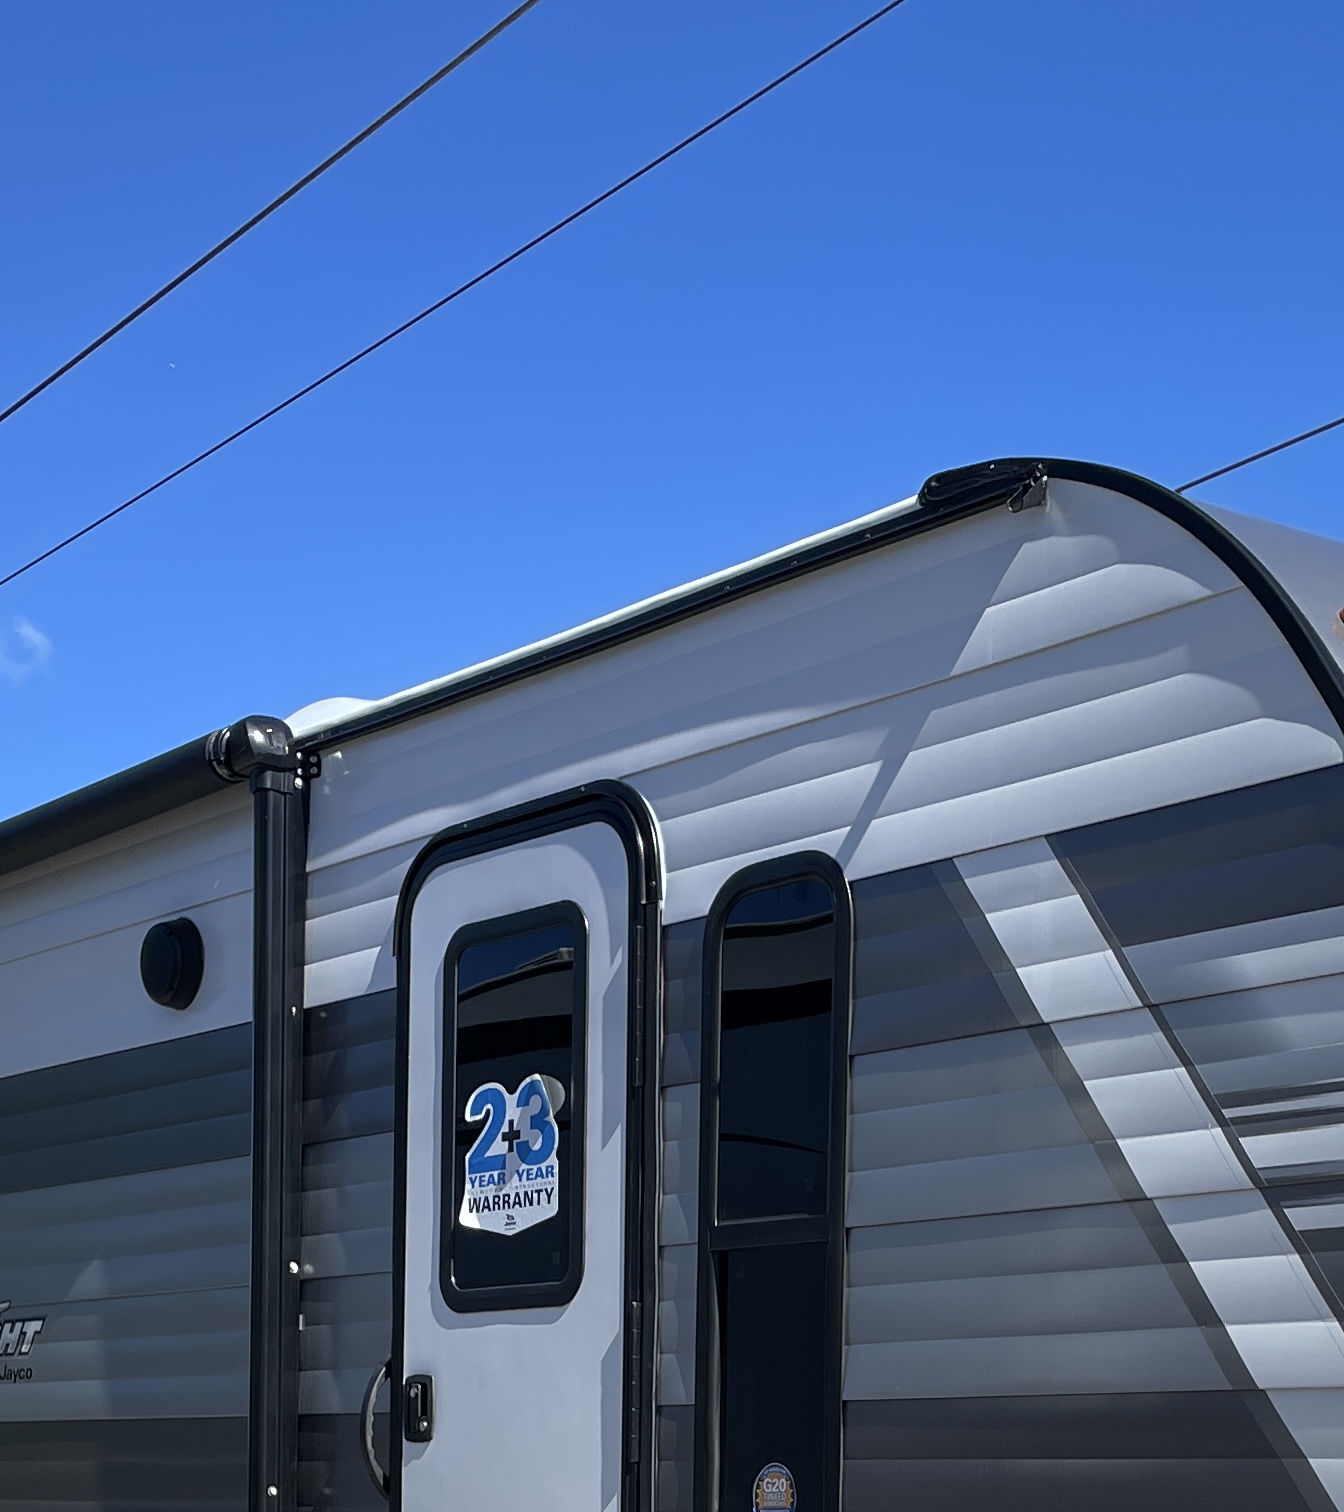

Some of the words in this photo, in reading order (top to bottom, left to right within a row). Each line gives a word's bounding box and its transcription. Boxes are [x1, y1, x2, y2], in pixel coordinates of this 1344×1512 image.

[468, 1172, 506, 1189] YEAR
[516, 1165, 555, 1183] YEAR
[468, 1187, 555, 1214] WARRANTY
[0, 1363, 33, 1384] Jayco
[763, 1478, 787, 1493] G20
